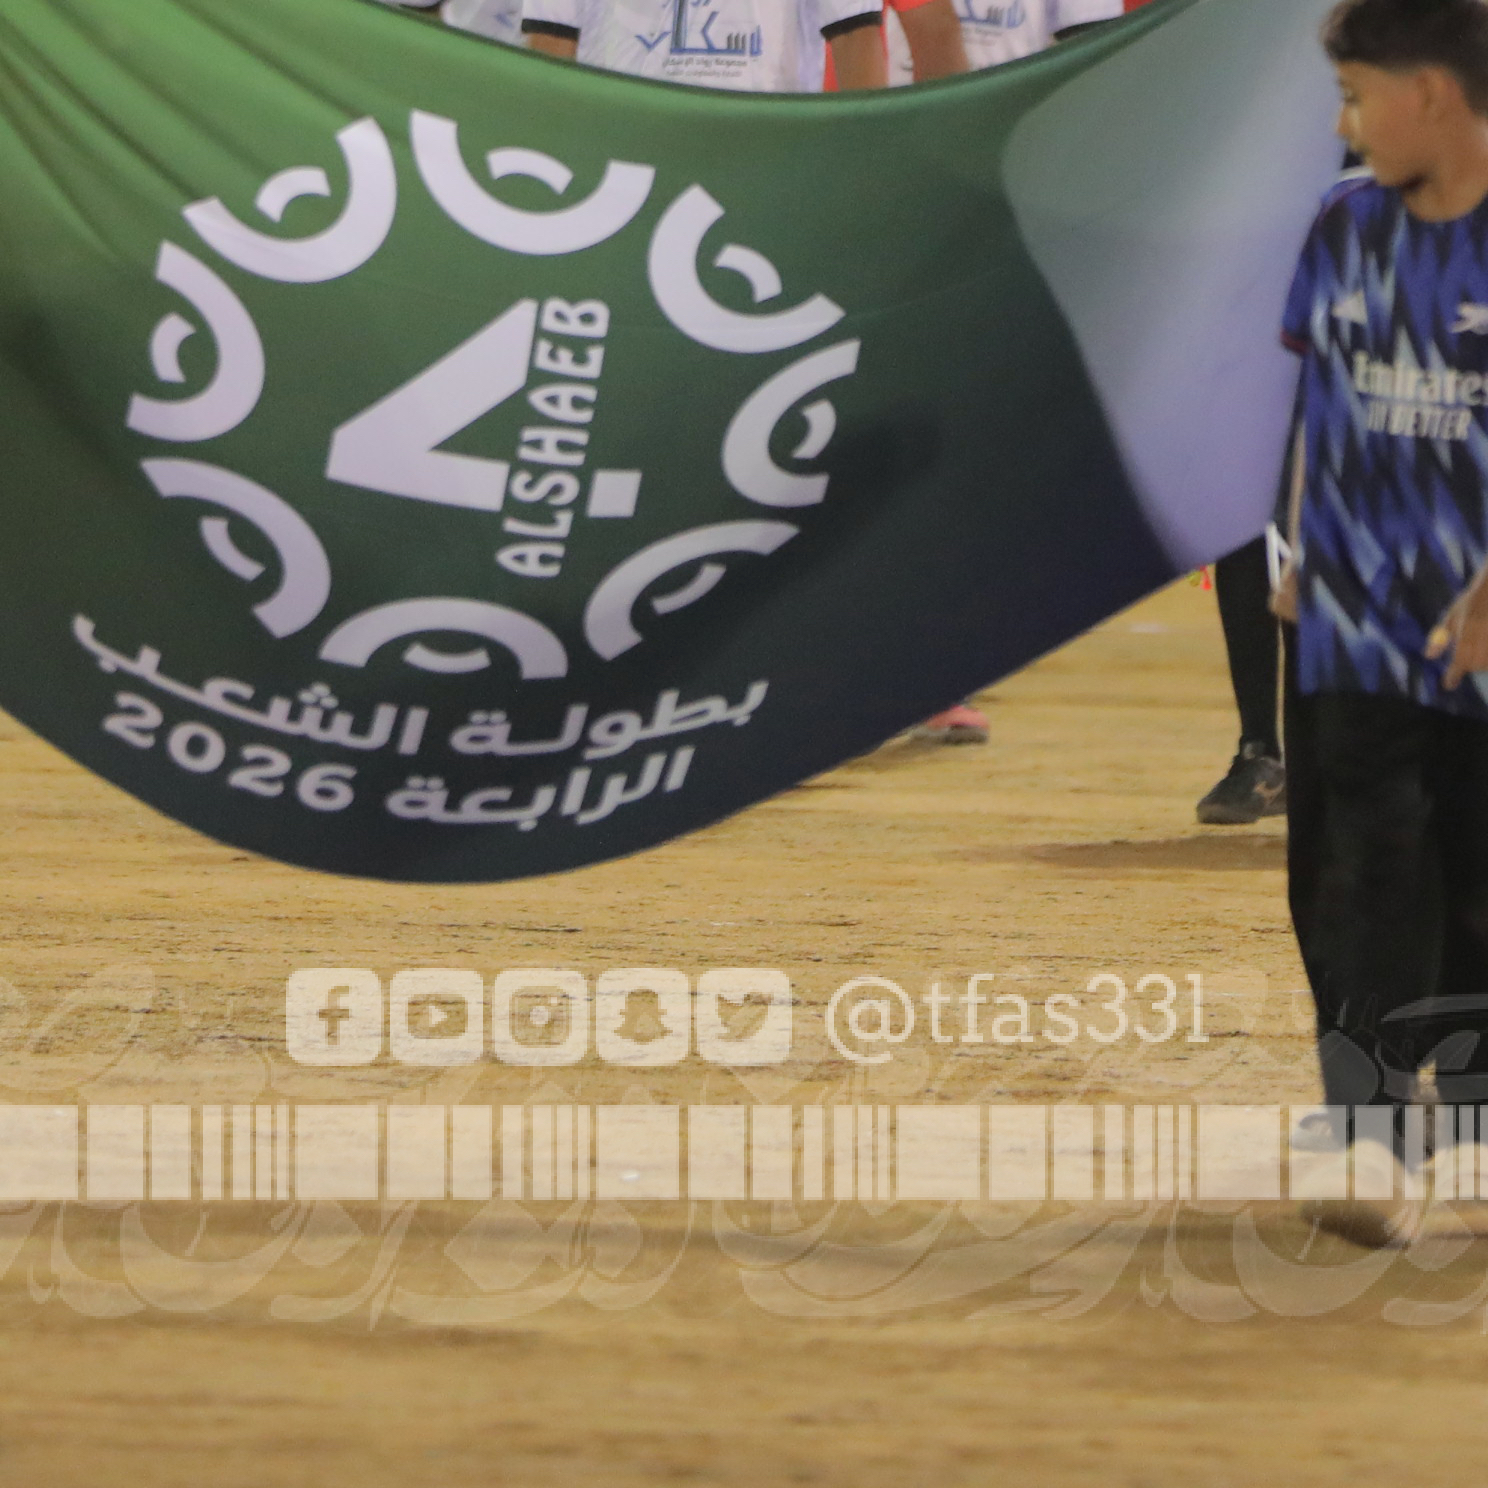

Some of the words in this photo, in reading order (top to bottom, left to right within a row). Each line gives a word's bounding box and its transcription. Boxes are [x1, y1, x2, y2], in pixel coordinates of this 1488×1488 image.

[495, 296, 611, 578] ALSHAEB
[103, 691, 359, 813] 2026
[449, 680, 770, 760] بطولة
[384, 747, 696, 831] الرابعة
